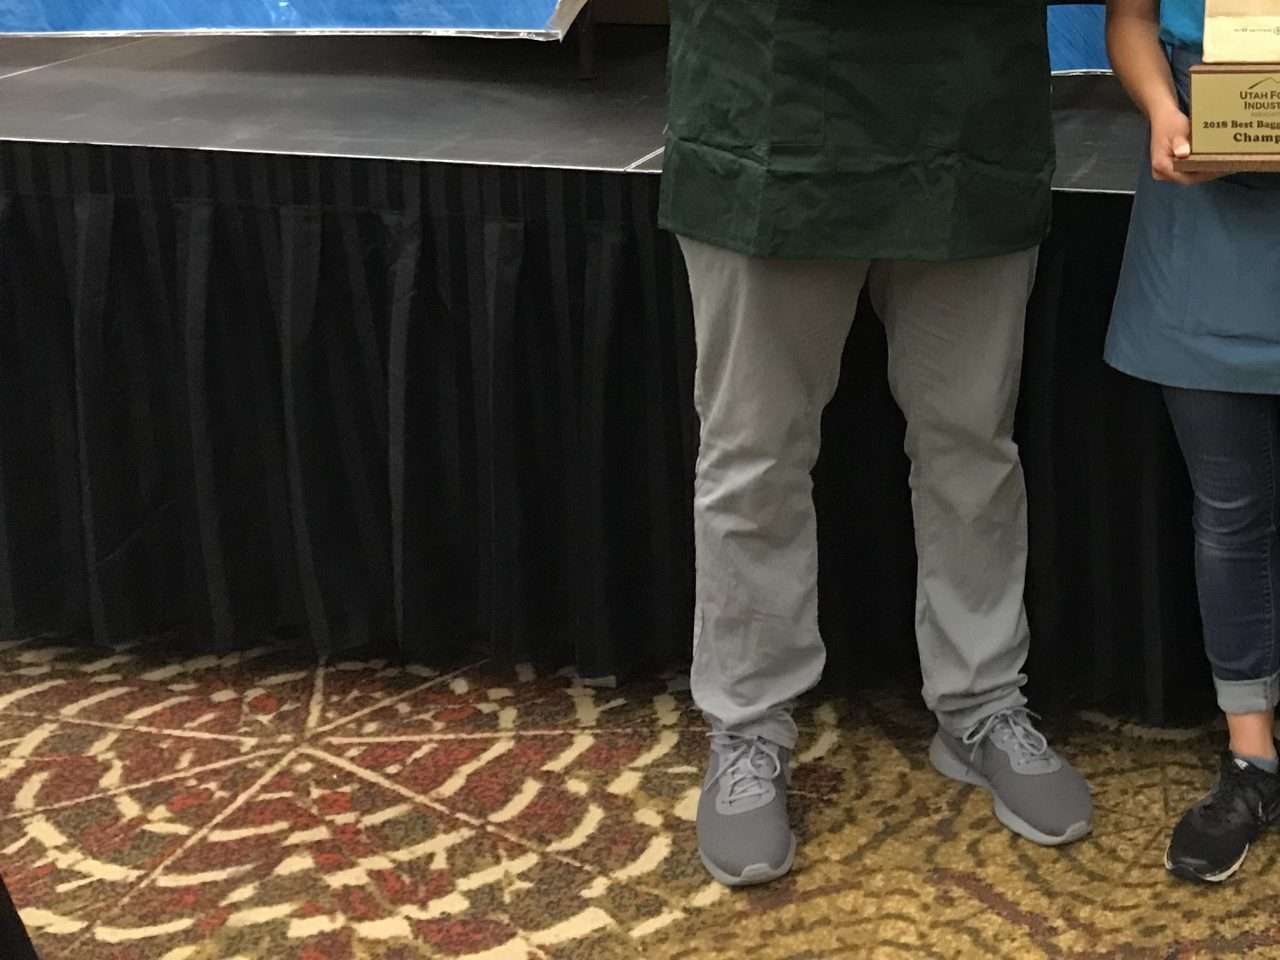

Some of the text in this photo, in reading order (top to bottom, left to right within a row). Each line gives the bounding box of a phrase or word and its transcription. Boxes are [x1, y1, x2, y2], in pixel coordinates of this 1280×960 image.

[1239, 91, 1268, 100] UTAH
[1203, 120, 1228, 129] 2018
[1231, 120, 1253, 129] Best
